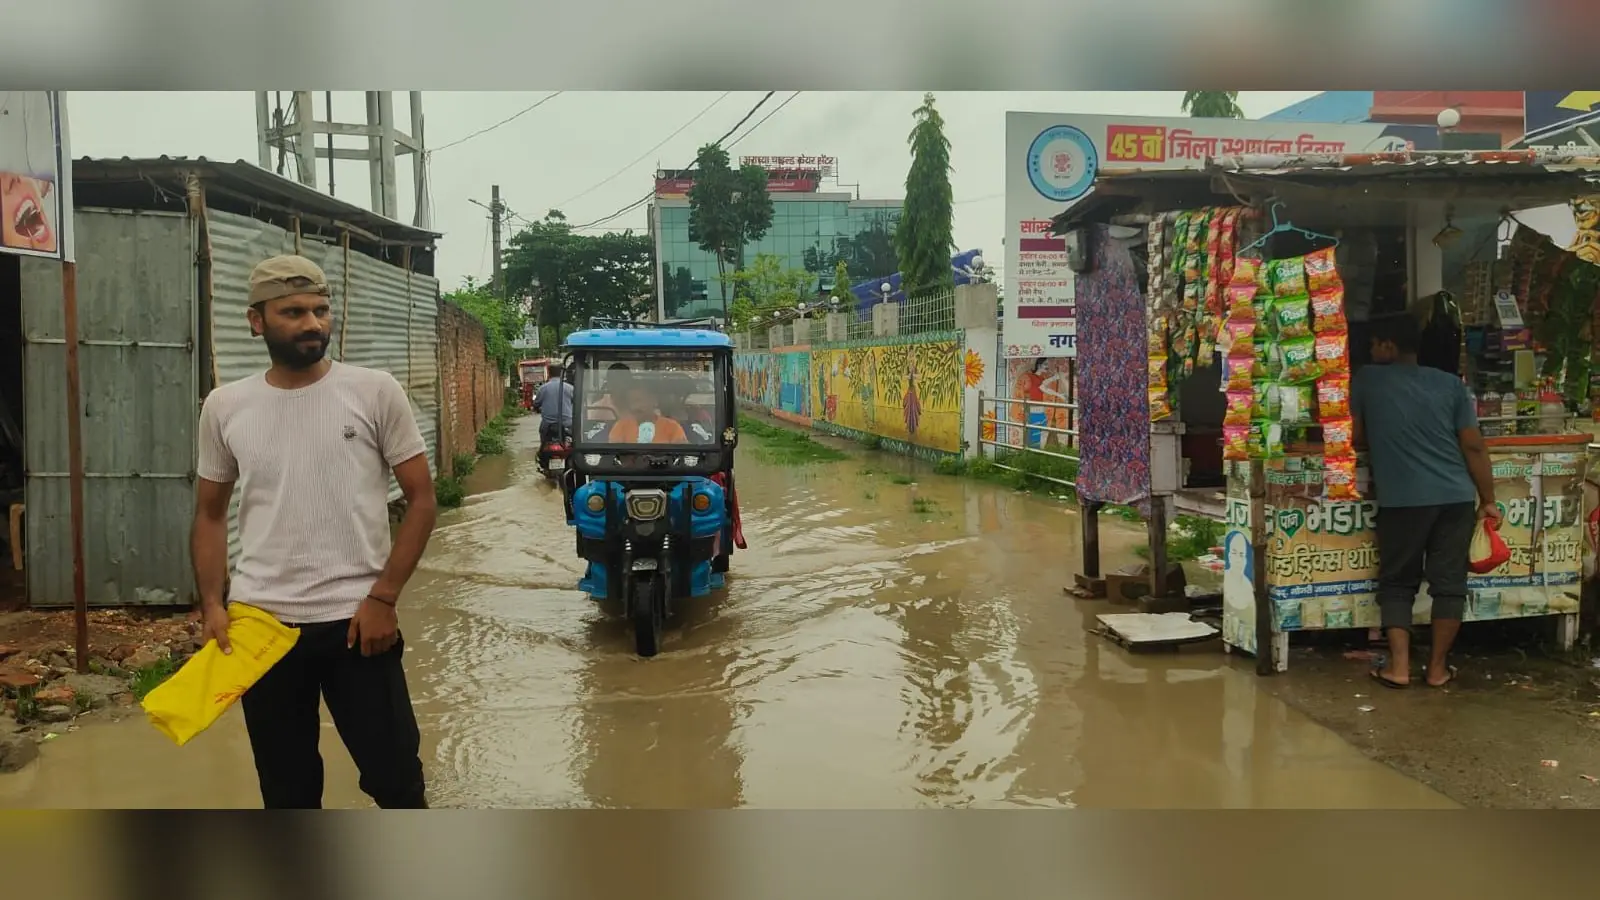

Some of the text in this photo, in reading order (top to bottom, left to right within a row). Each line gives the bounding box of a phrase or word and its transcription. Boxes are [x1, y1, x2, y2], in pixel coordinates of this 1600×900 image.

[1110, 133, 1138, 159] 45
[1140, 128, 1164, 160] वां
[1168, 129, 1218, 160] जिला
